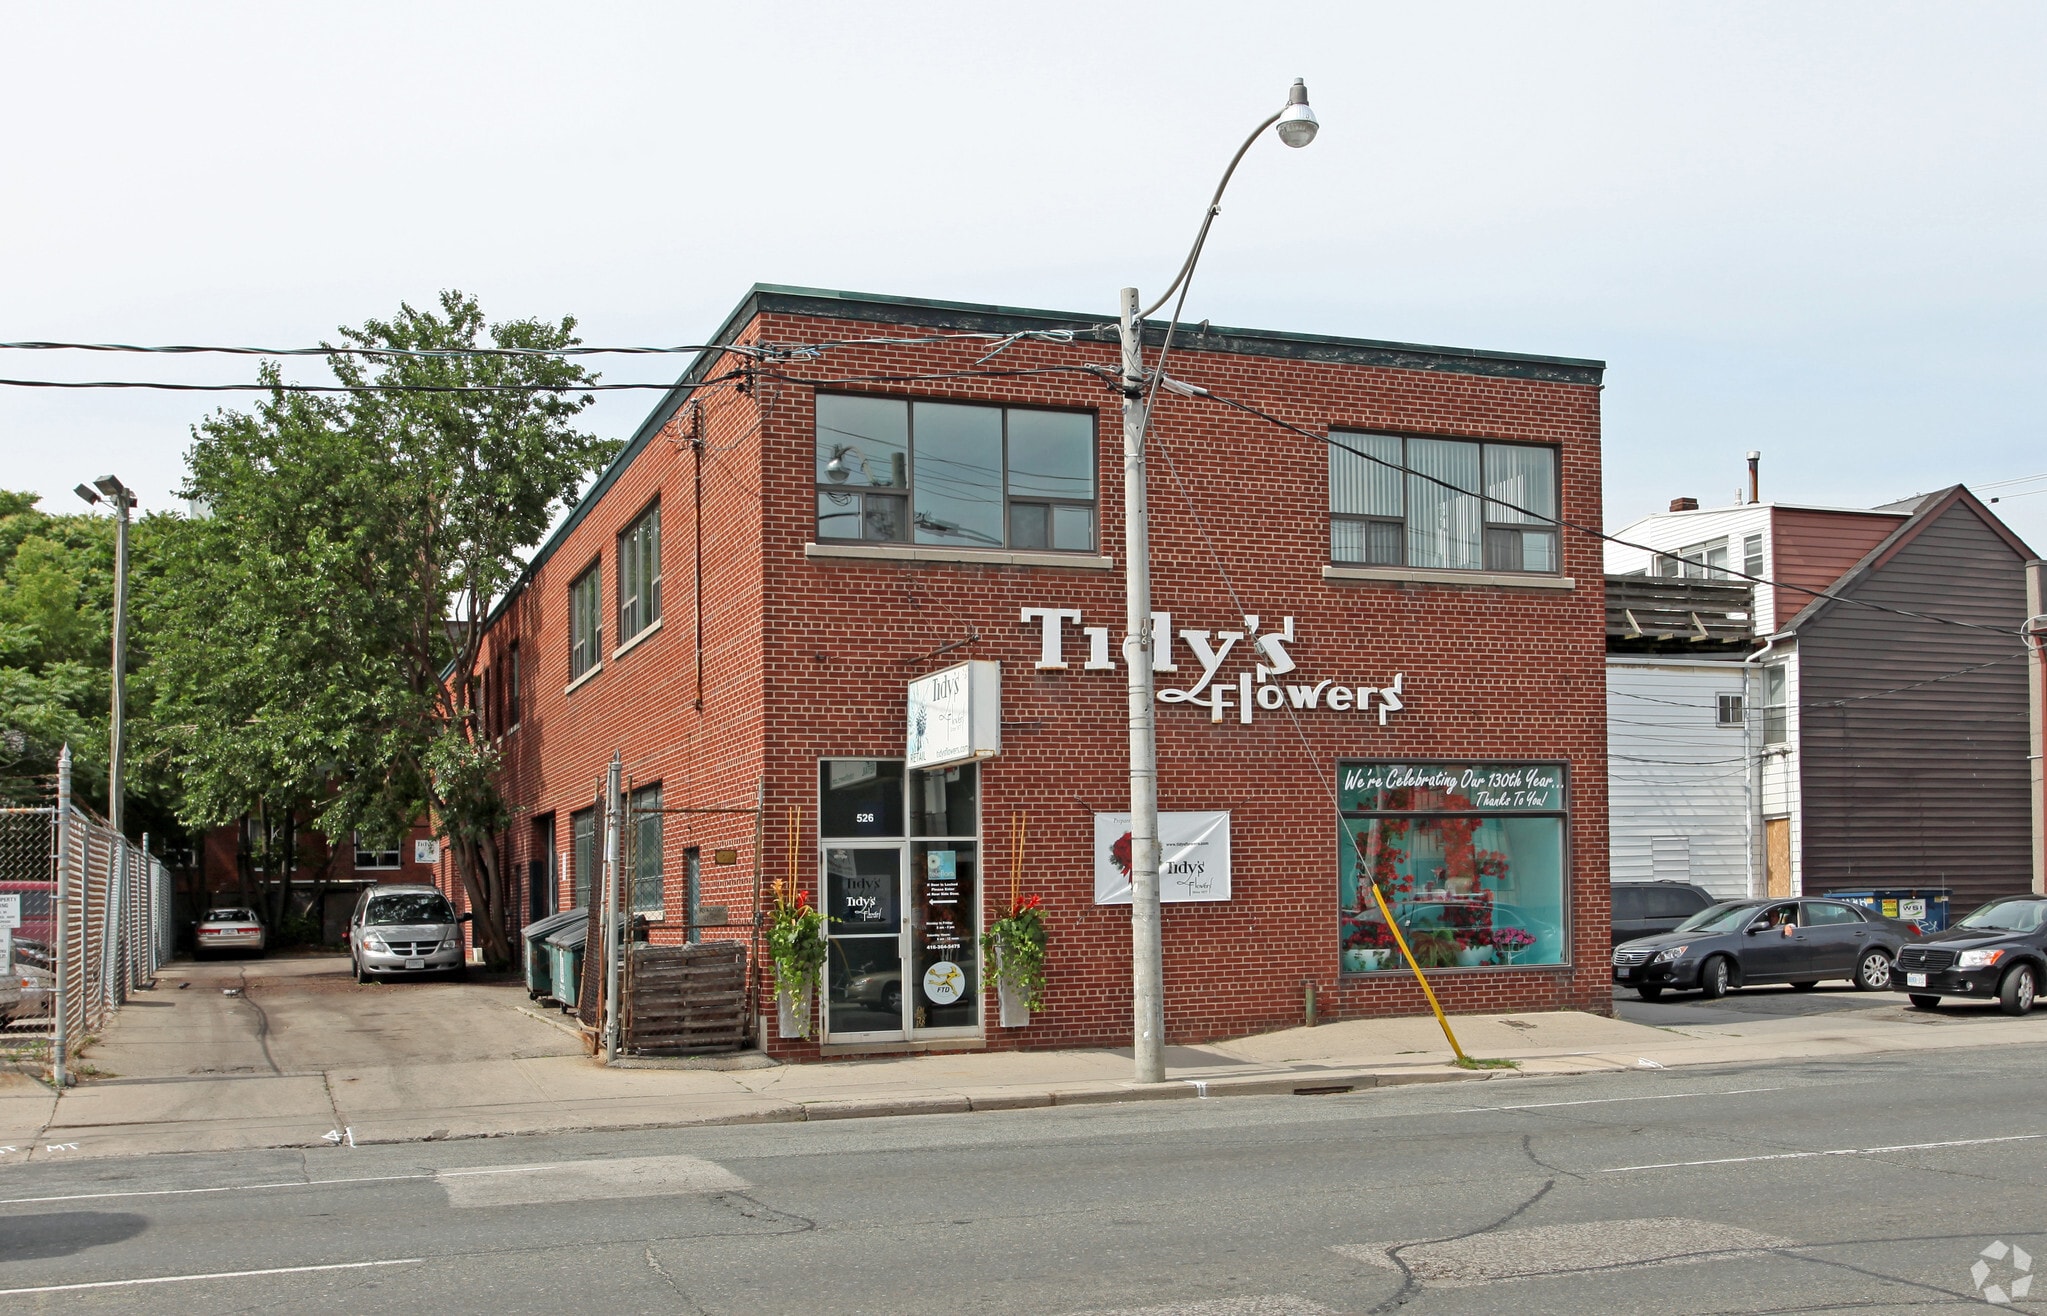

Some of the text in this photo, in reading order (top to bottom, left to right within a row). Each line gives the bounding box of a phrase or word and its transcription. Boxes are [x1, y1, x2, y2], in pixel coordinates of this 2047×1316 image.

[1021, 607, 1295, 704] Tidy's
[933, 672, 960, 703] Tidy's
[1211, 672, 1404, 726] Flowers
[910, 751, 927, 763] RETAIL
[1344, 768, 1383, 790] We're
[1386, 767, 1458, 795] Celebrating
[1460, 768, 1485, 788] Our
[1488, 769, 1522, 788] 130th
[1476, 790, 1548, 807] Thanks To You!
[856, 813, 874, 823] 526
[1165, 860, 1205, 877] Tidy's
[846, 896, 876, 909] Tidy's
